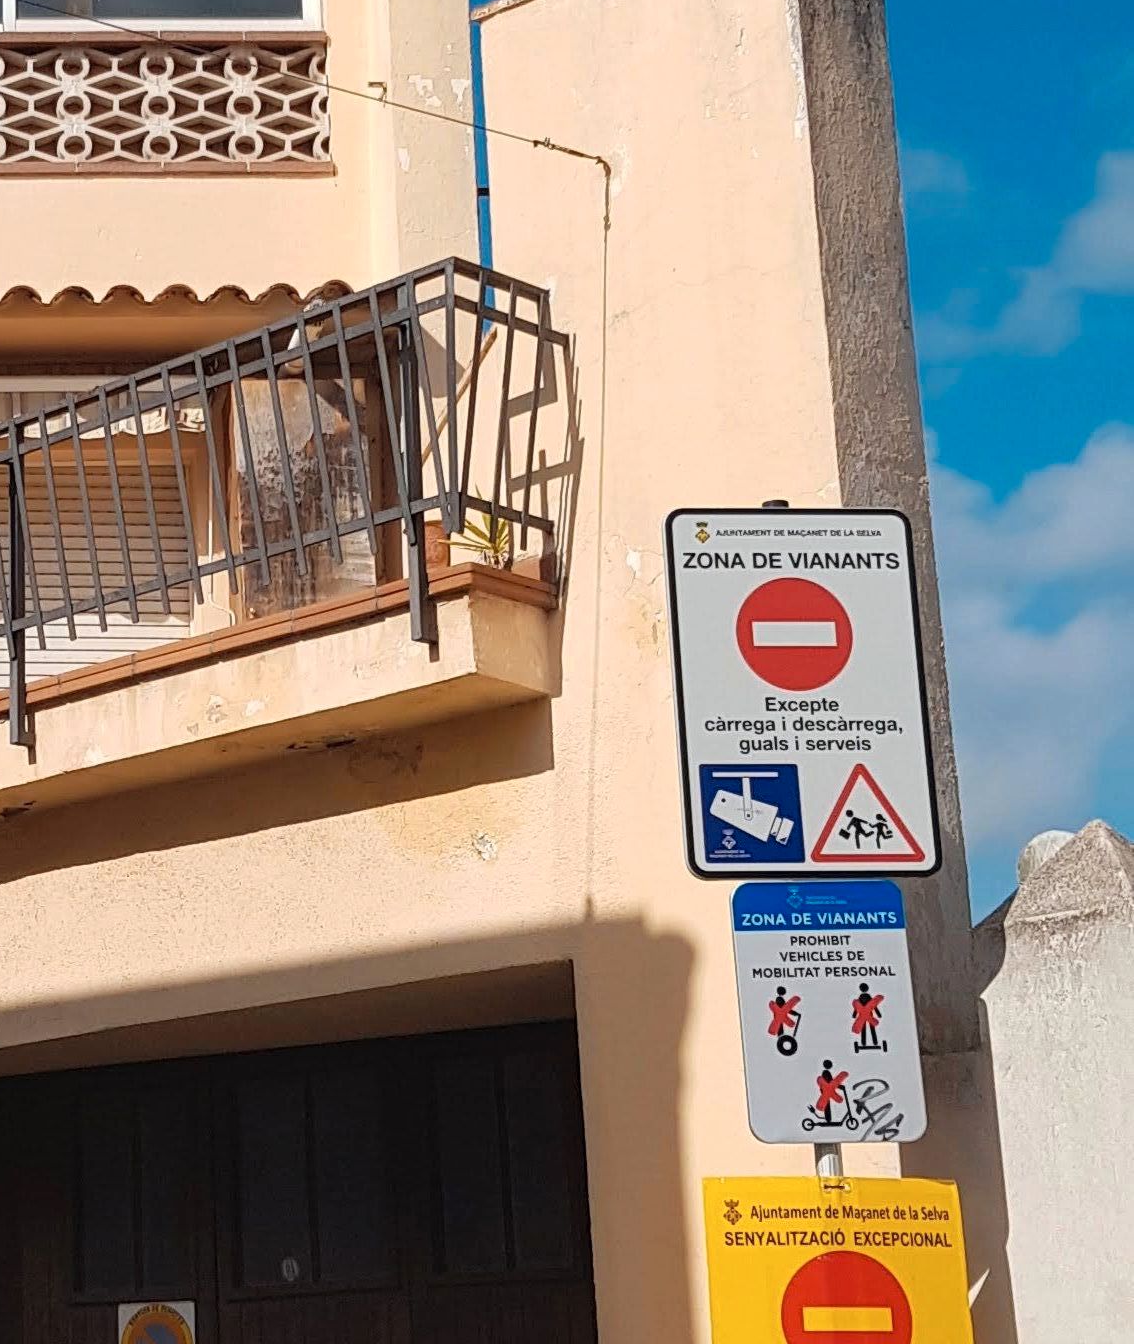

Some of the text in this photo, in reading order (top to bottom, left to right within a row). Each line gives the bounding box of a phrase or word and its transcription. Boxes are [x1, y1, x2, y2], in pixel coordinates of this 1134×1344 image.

[716, 529, 881, 539] AJUNTAMENT DE MAÇANET DE LA SELVA
[683, 552, 900, 569] ZONA DE VIANANTS
[765, 697, 839, 715] Excepte
[704, 716, 903, 735] càrrega i descàrrega,
[739, 736, 872, 754] guals i serveis
[741, 911, 897, 926] ZONA DE VIANANTS
[790, 935, 851, 946] PROHIBIT
[779, 950, 865, 962] VEHICLES DE
[752, 966, 896, 979] MOBILITAT PERSONAL
[750, 1204, 949, 1222] Ajuntament de Maçanet de la Selva
[725, 1228, 953, 1248] SENYALITZACIÓ EXCEPCIONAL
